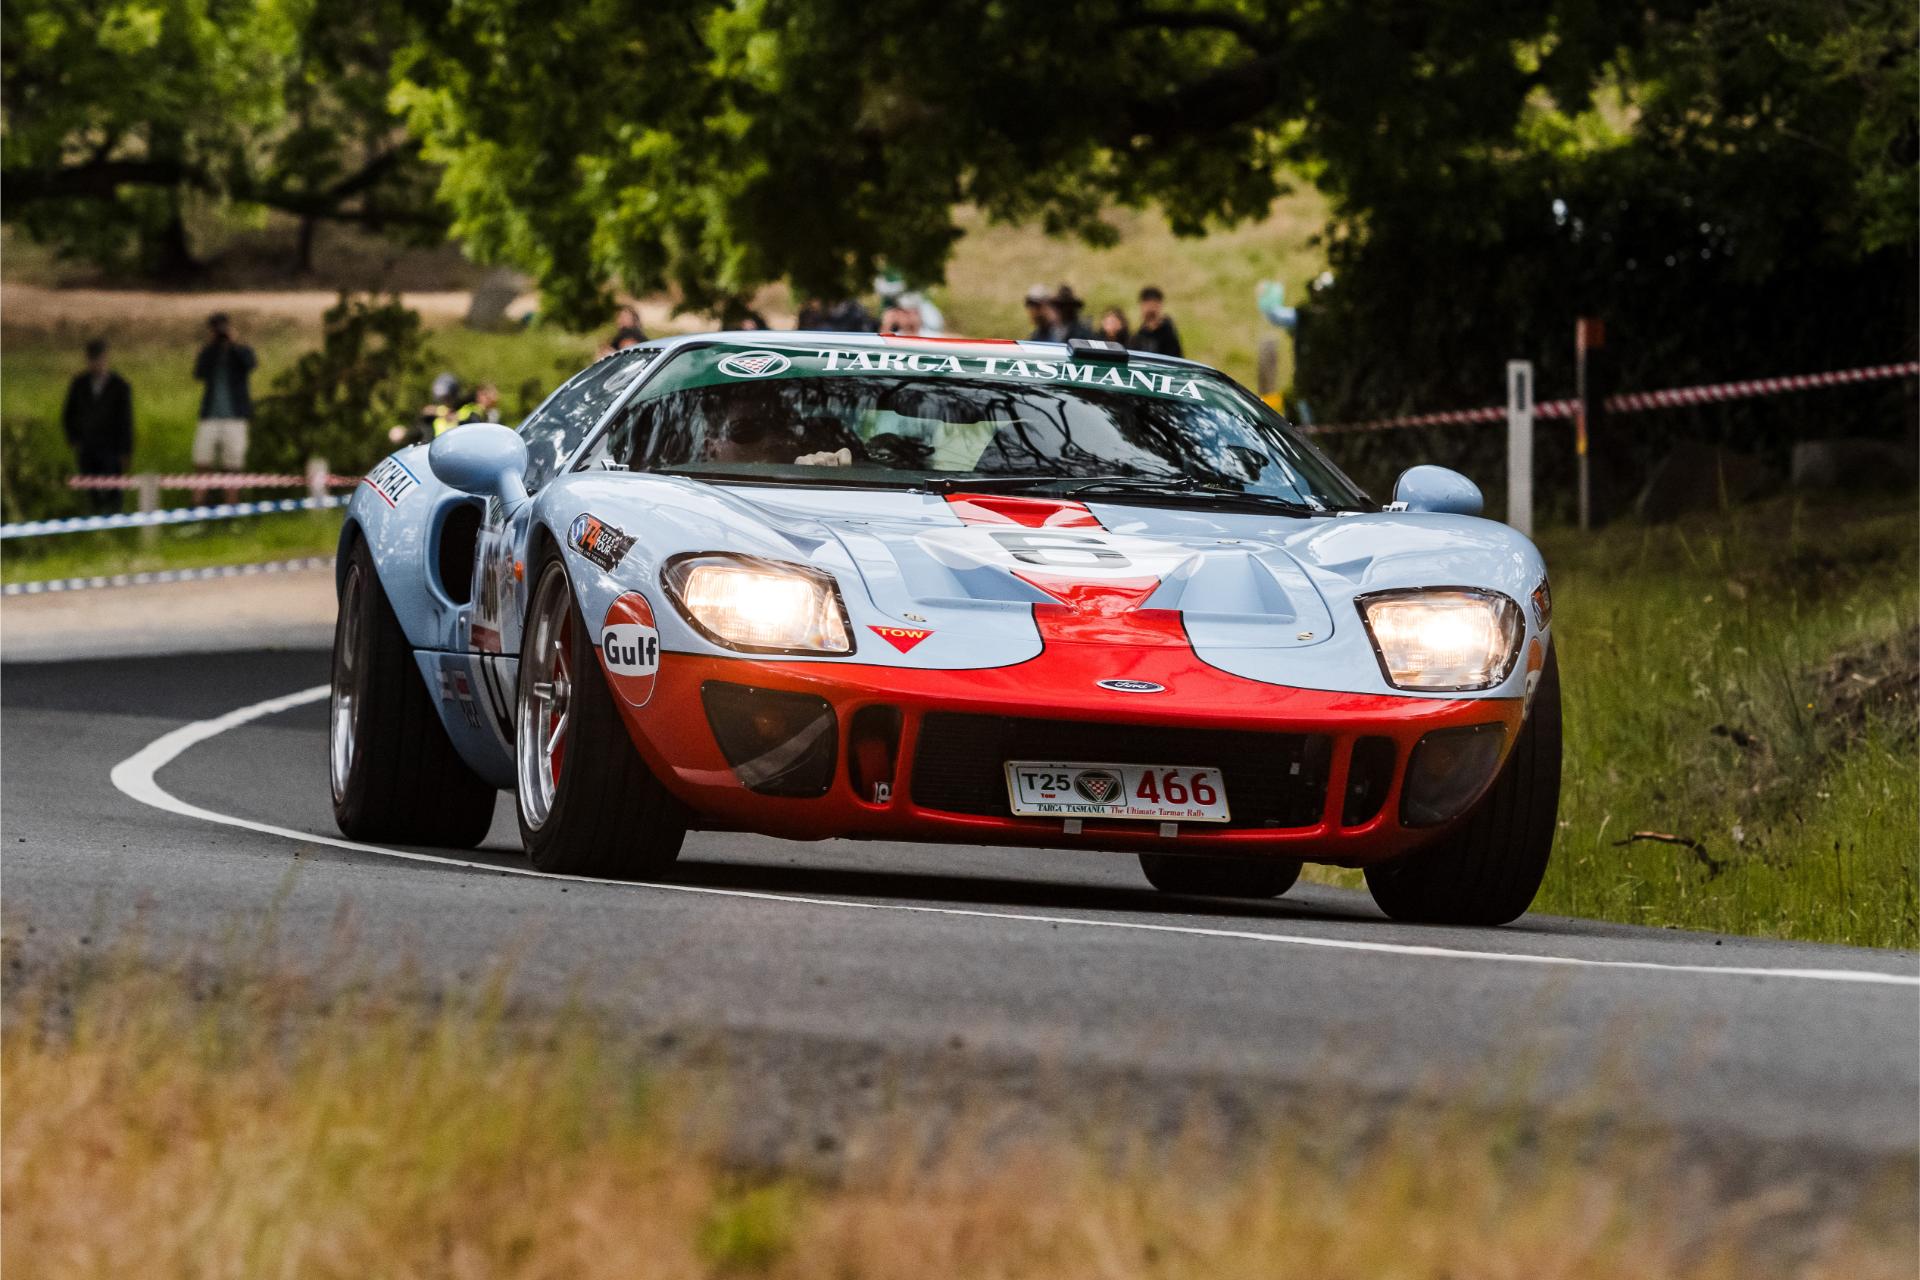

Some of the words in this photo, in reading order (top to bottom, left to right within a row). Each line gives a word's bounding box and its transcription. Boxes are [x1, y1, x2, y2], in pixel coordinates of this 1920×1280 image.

[818, 350, 966, 373] TARGA
[976, 357, 1206, 401] TASMANIA
[594, 539, 612, 556] TOUR
[877, 627, 925, 639] TOW
[604, 632, 657, 666] Gulf
[1114, 681, 1148, 689] Ford
[1021, 773, 1071, 791] T25
[1136, 770, 1217, 806] 466
[1037, 803, 1063, 813] TARGA
[1066, 805, 1105, 814] TASMANIA
[1110, 806, 1124, 814] The
[1126, 807, 1157, 815] Ultimate
[1159, 808, 1185, 817] Tarmac
[1187, 809, 1205, 818] Rally
